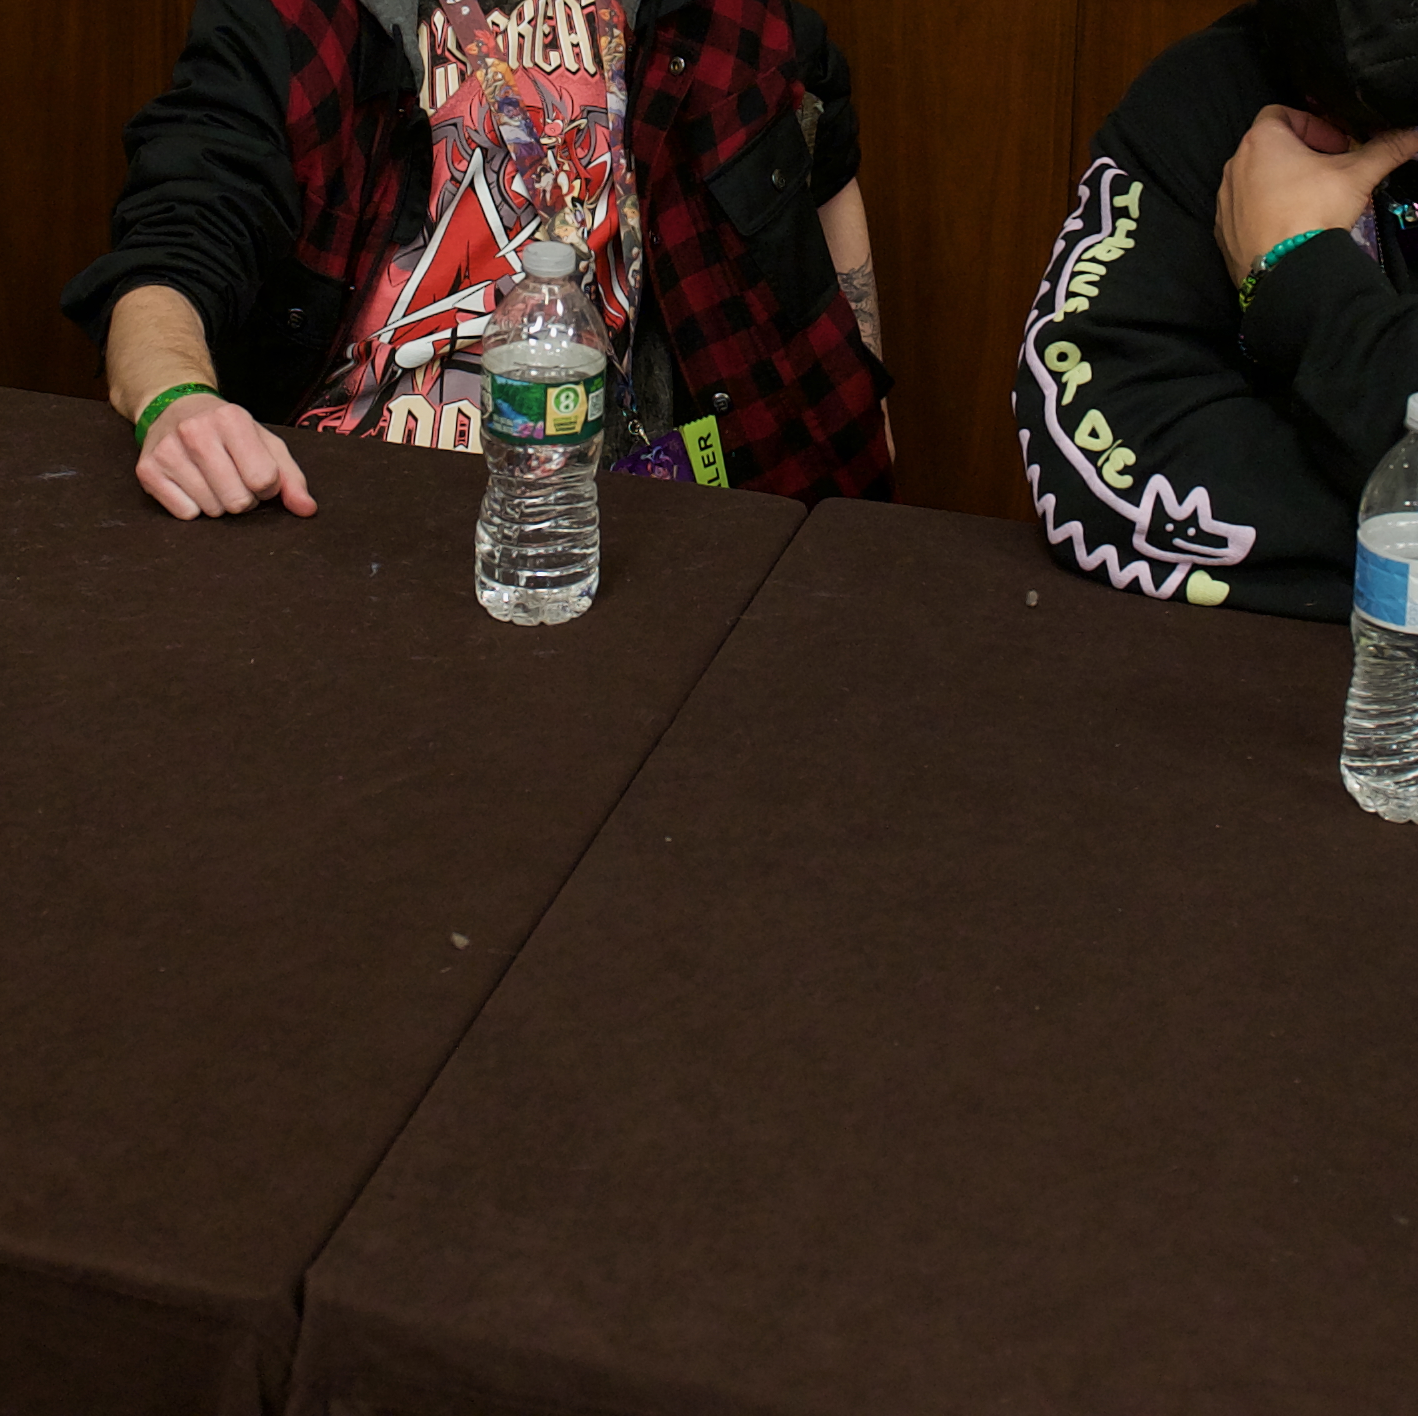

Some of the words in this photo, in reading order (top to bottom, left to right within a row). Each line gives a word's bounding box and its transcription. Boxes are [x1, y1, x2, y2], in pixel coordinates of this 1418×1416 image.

[1053, 181, 1143, 322] THRIVE
[1044, 341, 1093, 406] OR
[698, 432, 721, 486] LER
[1074, 409, 1136, 489] DIE
